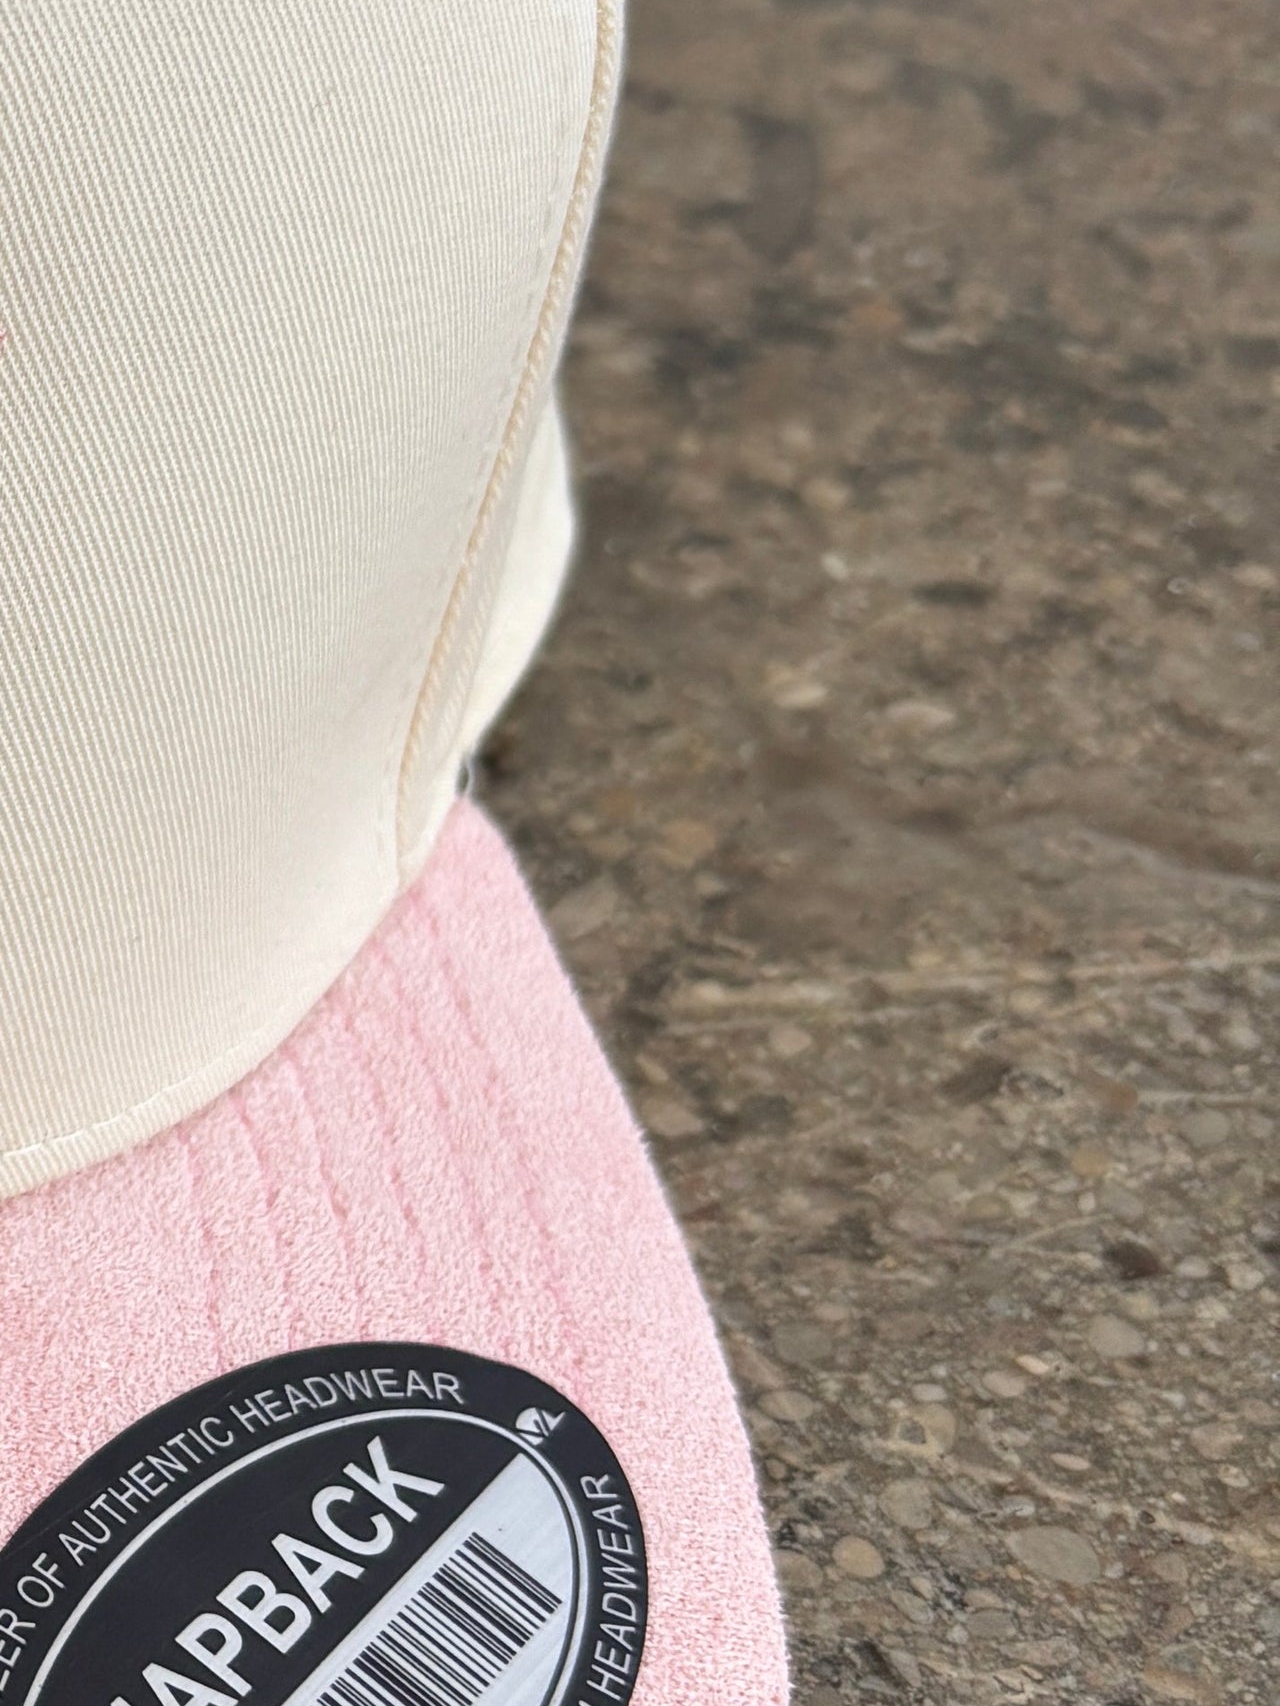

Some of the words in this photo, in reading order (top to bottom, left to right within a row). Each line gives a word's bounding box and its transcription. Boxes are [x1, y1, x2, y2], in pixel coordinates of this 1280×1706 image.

[16, 1552, 67, 1608] OF
[58, 1416, 236, 1569] AUTHENTIC
[239, 1366, 465, 1433] HEADWEAR
[587, 1473, 639, 1701] HEADWEAR
